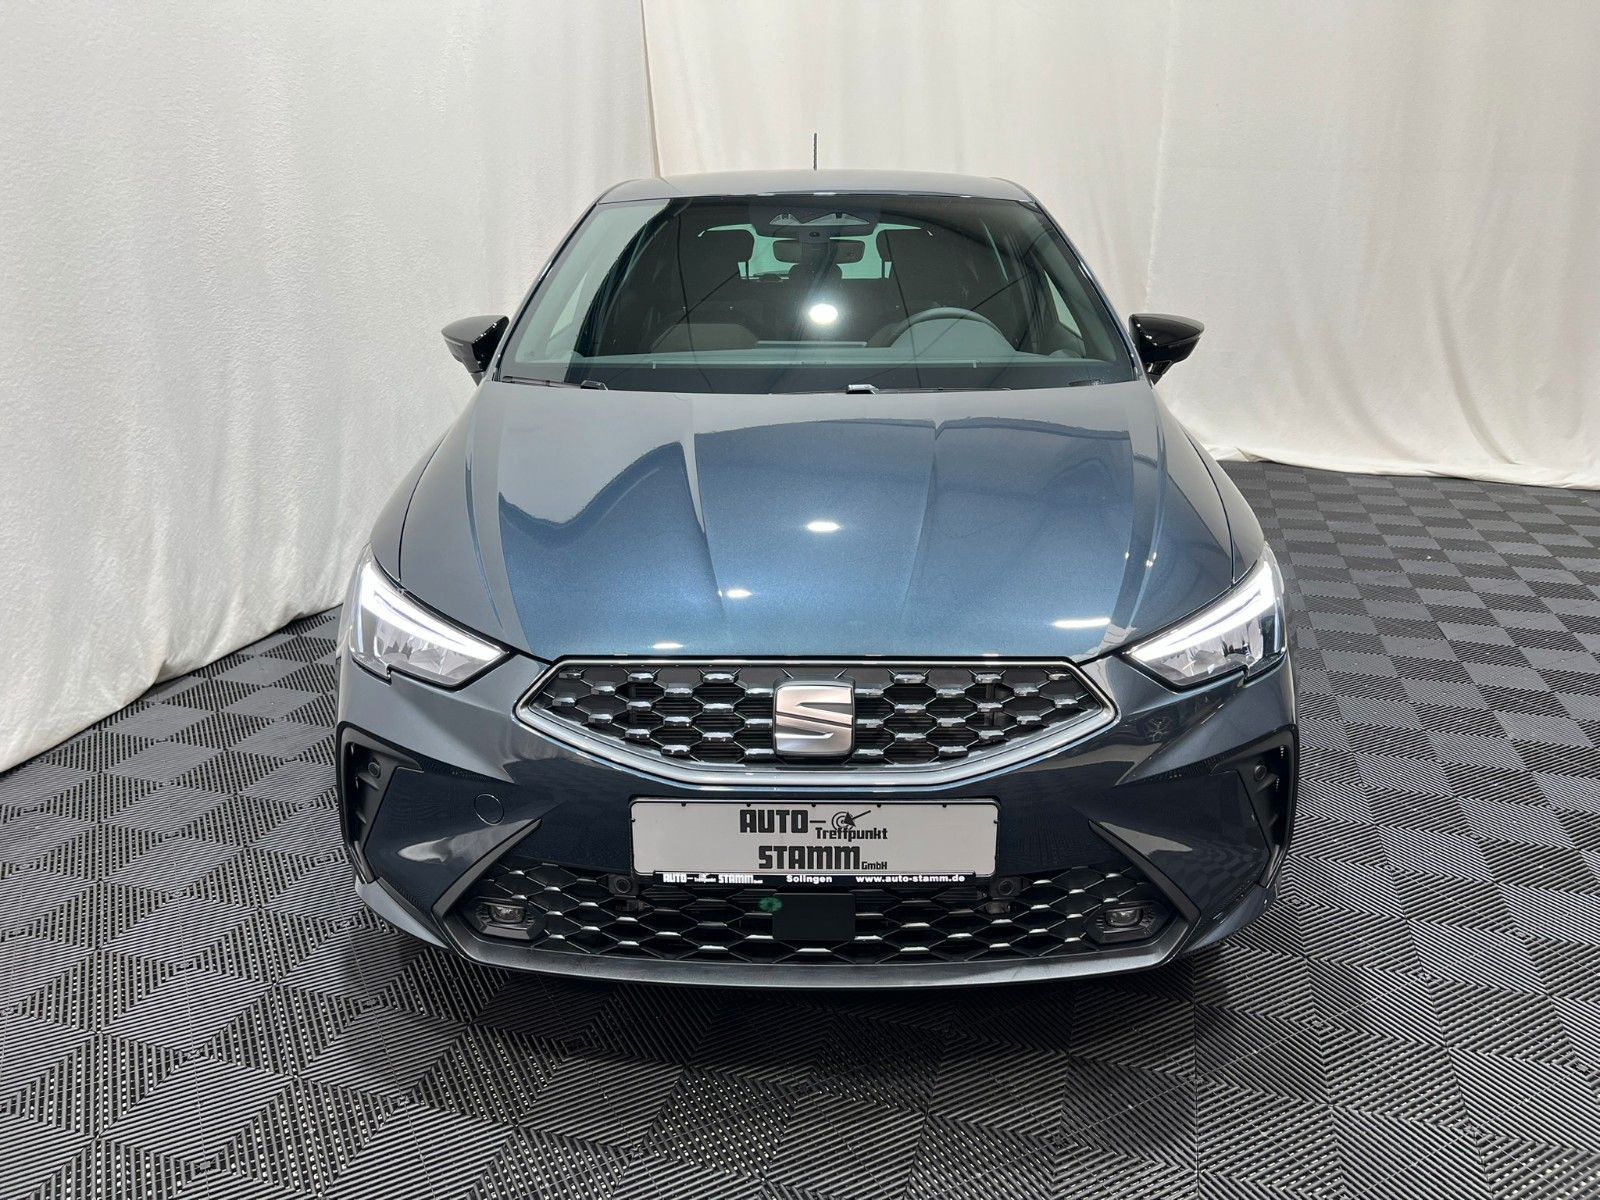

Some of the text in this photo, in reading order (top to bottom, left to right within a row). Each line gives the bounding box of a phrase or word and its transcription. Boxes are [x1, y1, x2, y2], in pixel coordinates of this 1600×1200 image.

[815, 827, 888, 842] Treffpunkt
[758, 845, 888, 870] STAMM GmbH
[786, 874, 833, 884] Solingen
[855, 874, 966, 883] www.auto-stamm.de
